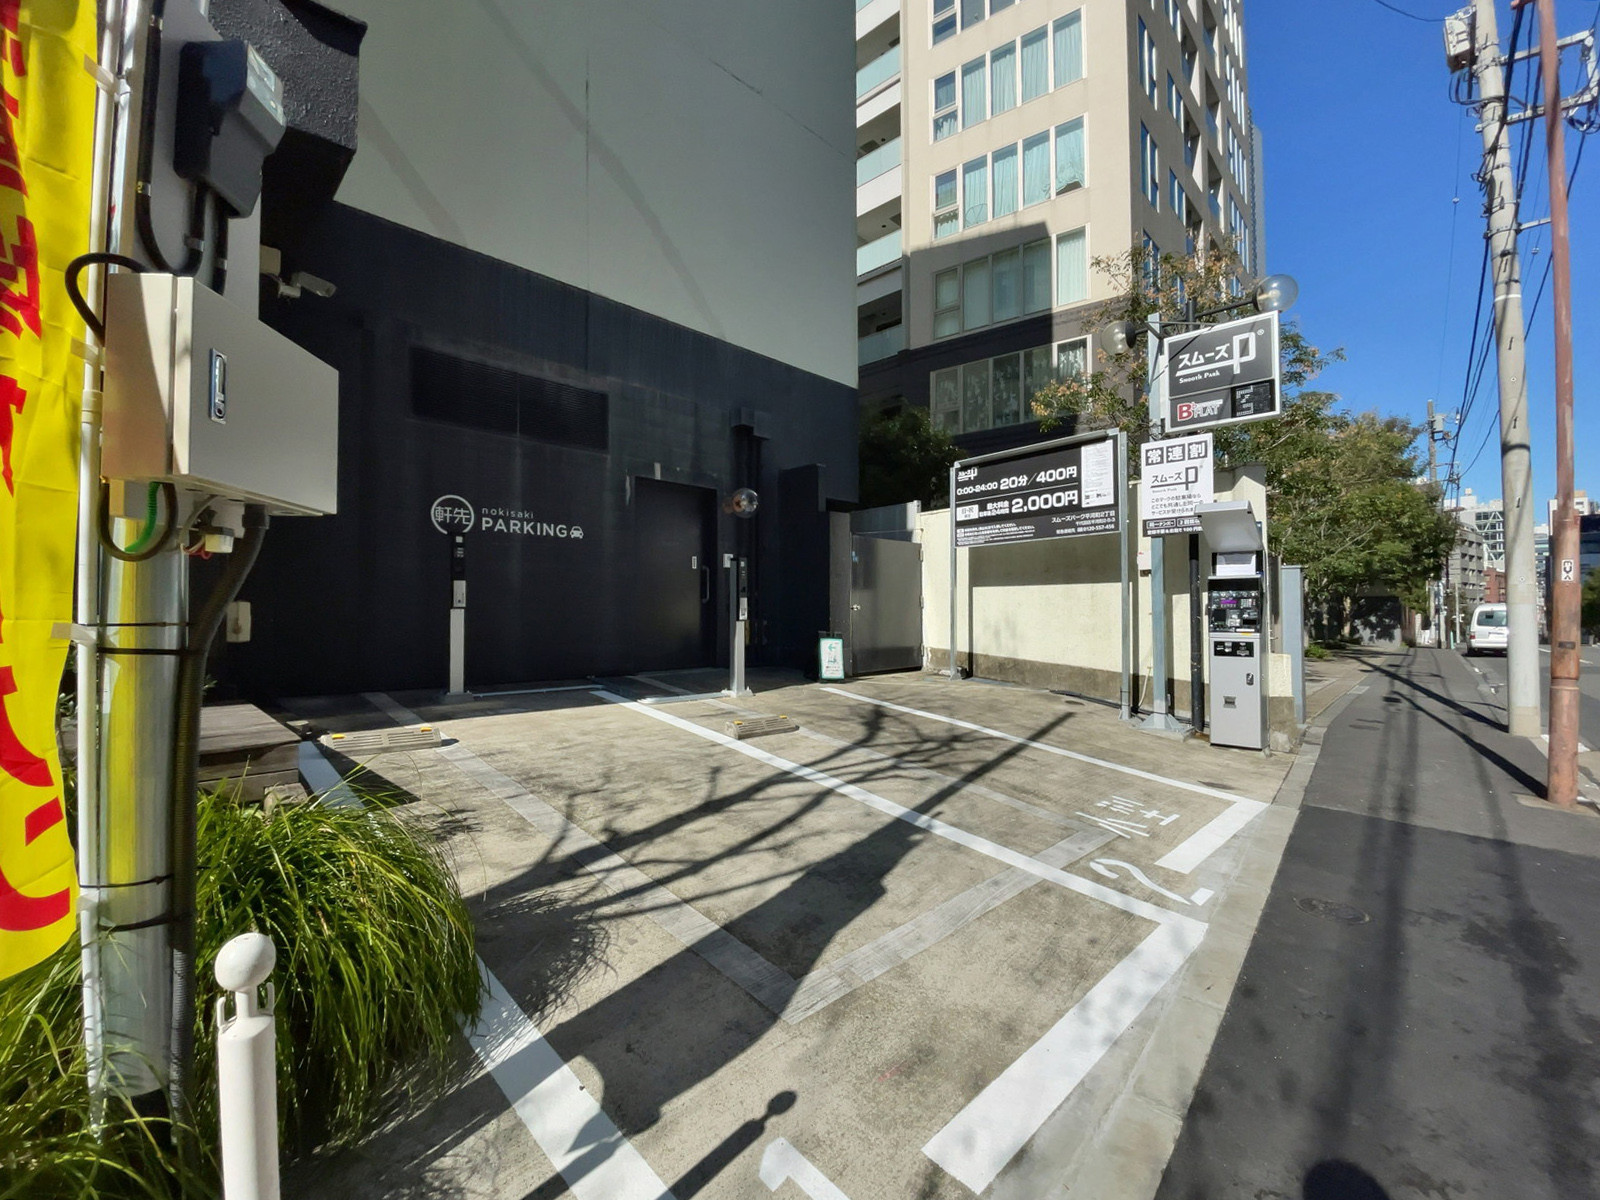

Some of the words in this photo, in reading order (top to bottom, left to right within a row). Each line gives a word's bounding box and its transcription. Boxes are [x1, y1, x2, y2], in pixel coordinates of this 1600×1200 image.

[1178, 343, 1231, 369] スムーズ
[1179, 373, 1203, 384] Smooth
[1146, 441, 1208, 465] 常連割
[1152, 471, 1183, 484] スムーズ
[956, 481, 999, 496] 0:00-24:00
[1011, 489, 1079, 514] 2,000円
[435, 506, 470, 525] 軒先
[481, 507, 534, 519] nokisaki
[481, 517, 568, 538] PARKING
